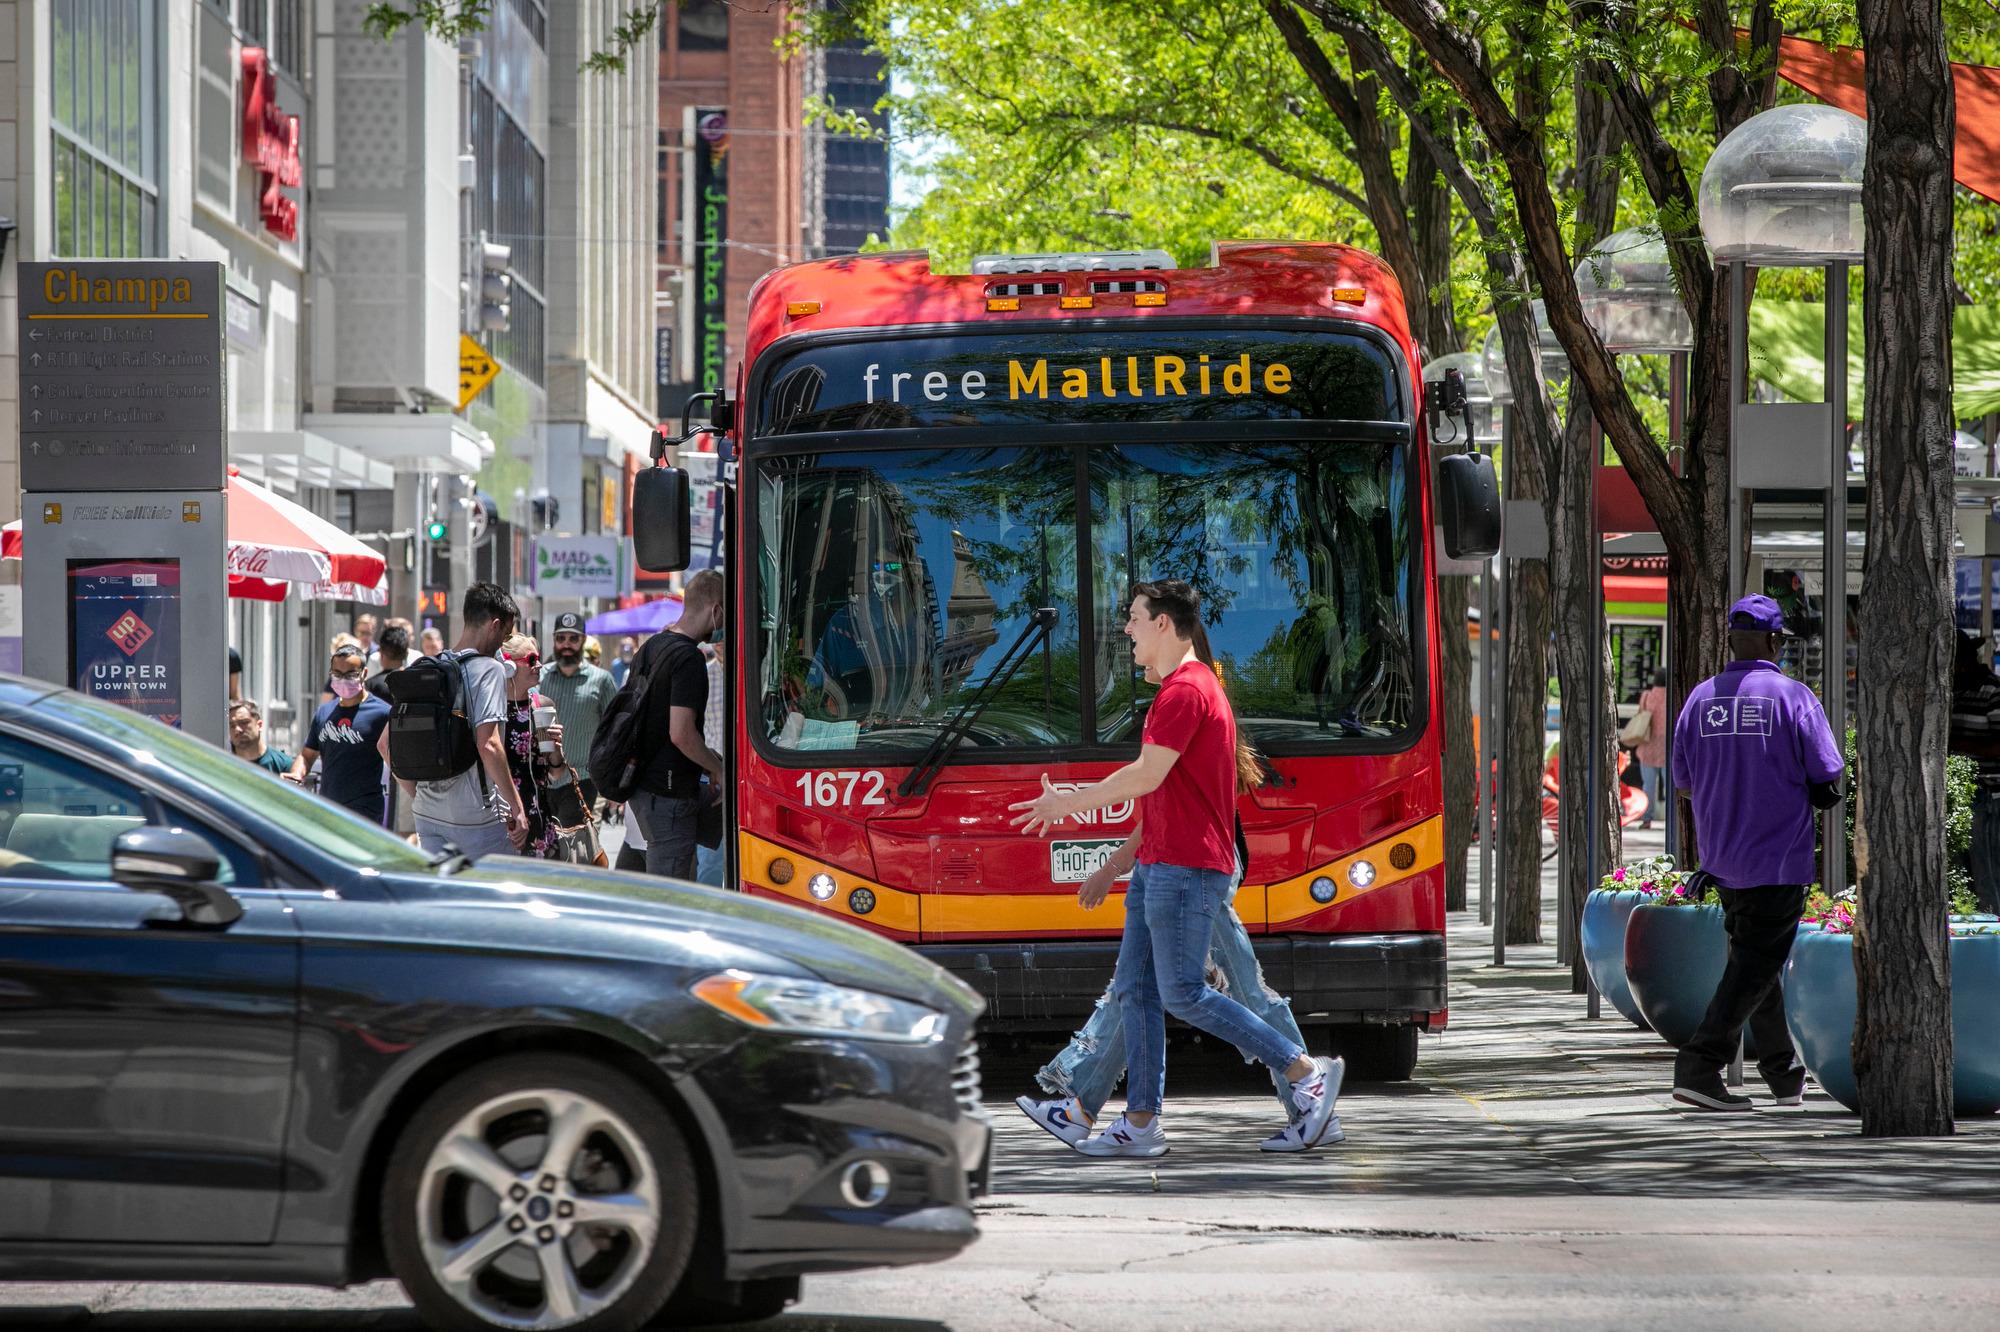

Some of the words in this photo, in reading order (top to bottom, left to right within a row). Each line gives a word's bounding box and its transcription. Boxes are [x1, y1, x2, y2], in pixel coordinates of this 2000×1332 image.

[704, 185, 728, 305] Jamba
[44, 268, 192, 312] Champa
[48, 328, 97, 342] Federal
[103, 327, 153, 342] District
[121, 351, 148, 367] Rail
[151, 351, 211, 367] Stations
[863, 363, 987, 404] free
[1008, 353, 1293, 401] MallRide
[84, 383, 163, 400] Convention
[165, 383, 211, 400] Center
[49, 408, 97, 424] Denver
[73, 505, 109, 521] FREE
[111, 505, 173, 521] MallRide
[551, 550, 591, 565] MAD
[562, 565, 613, 579] greens
[94, 665, 167, 679] UPPER
[95, 682, 168, 690] DOWNTOWN
[795, 770, 886, 807] 1672
